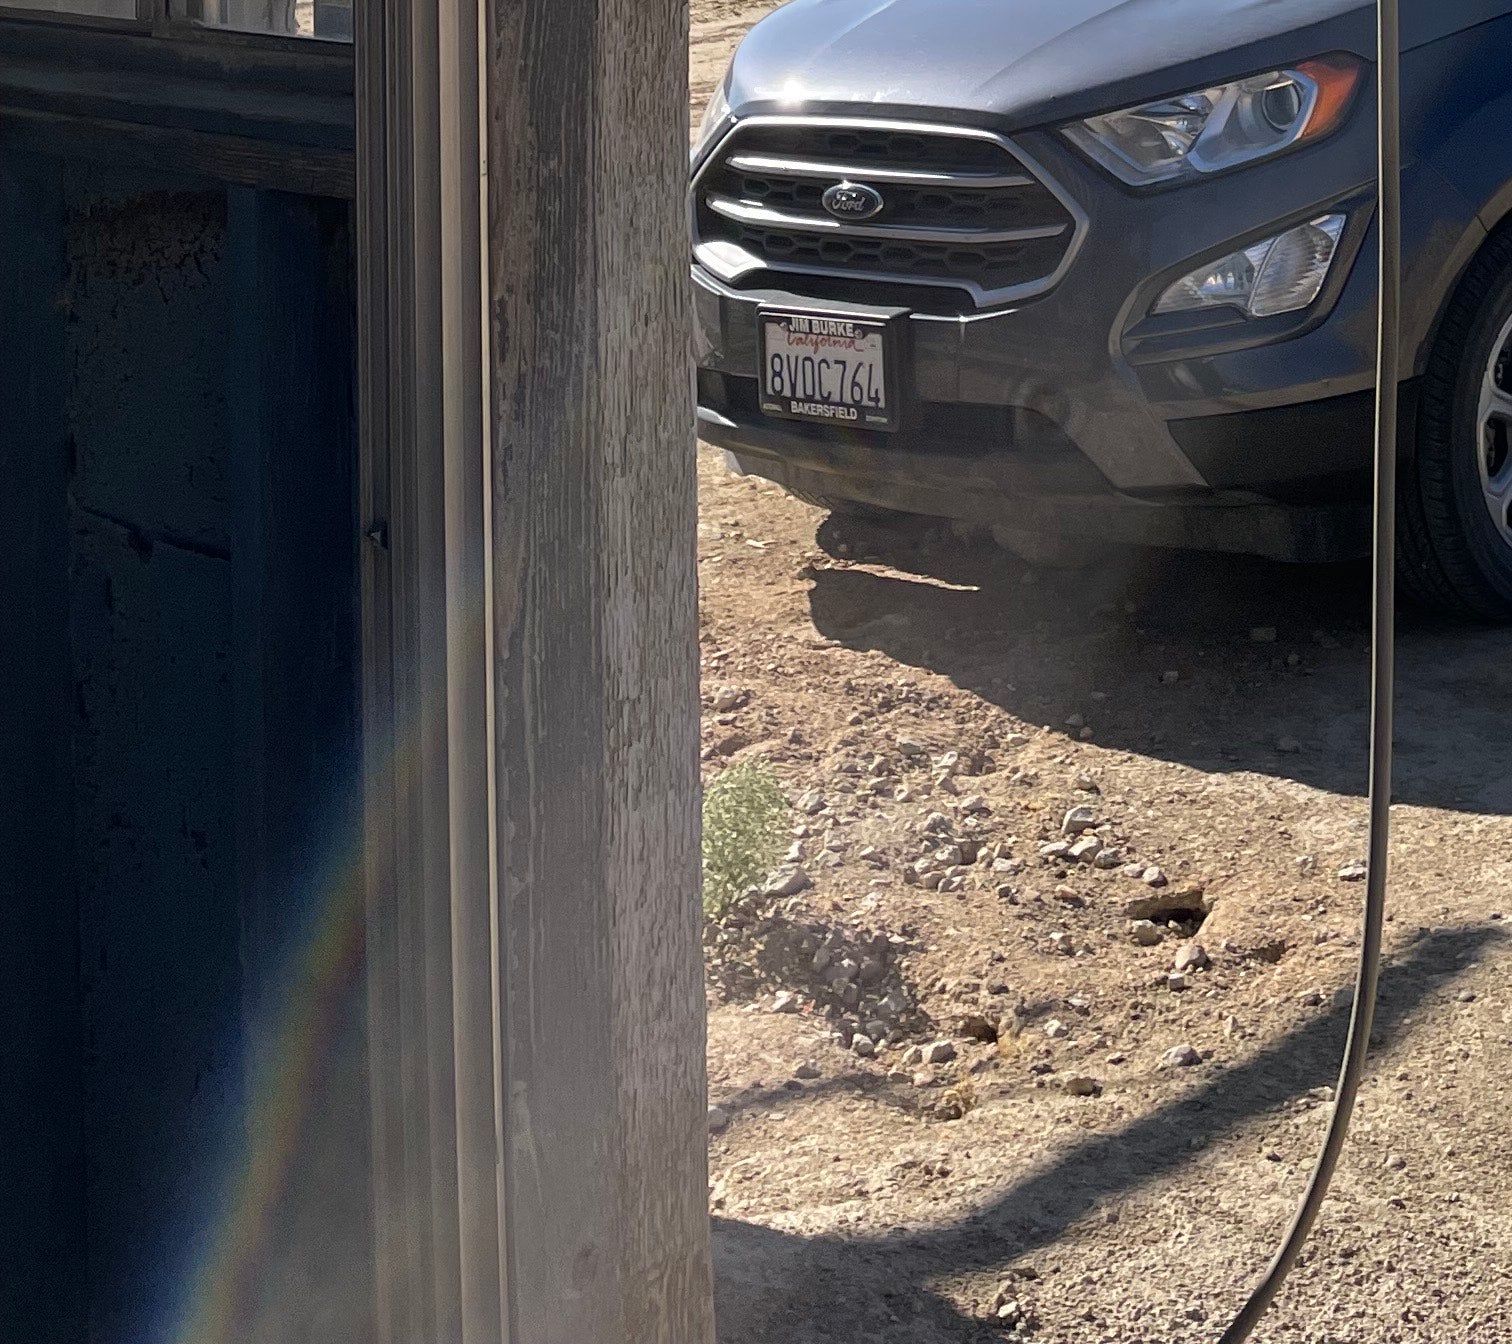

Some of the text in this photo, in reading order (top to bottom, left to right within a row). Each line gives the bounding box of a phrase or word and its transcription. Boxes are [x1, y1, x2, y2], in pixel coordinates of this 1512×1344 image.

[832, 190, 866, 211] Ford
[789, 317, 855, 337] JIM BURKE
[787, 332, 864, 354] California
[790, 401, 858, 420] BAKERSFIELD
